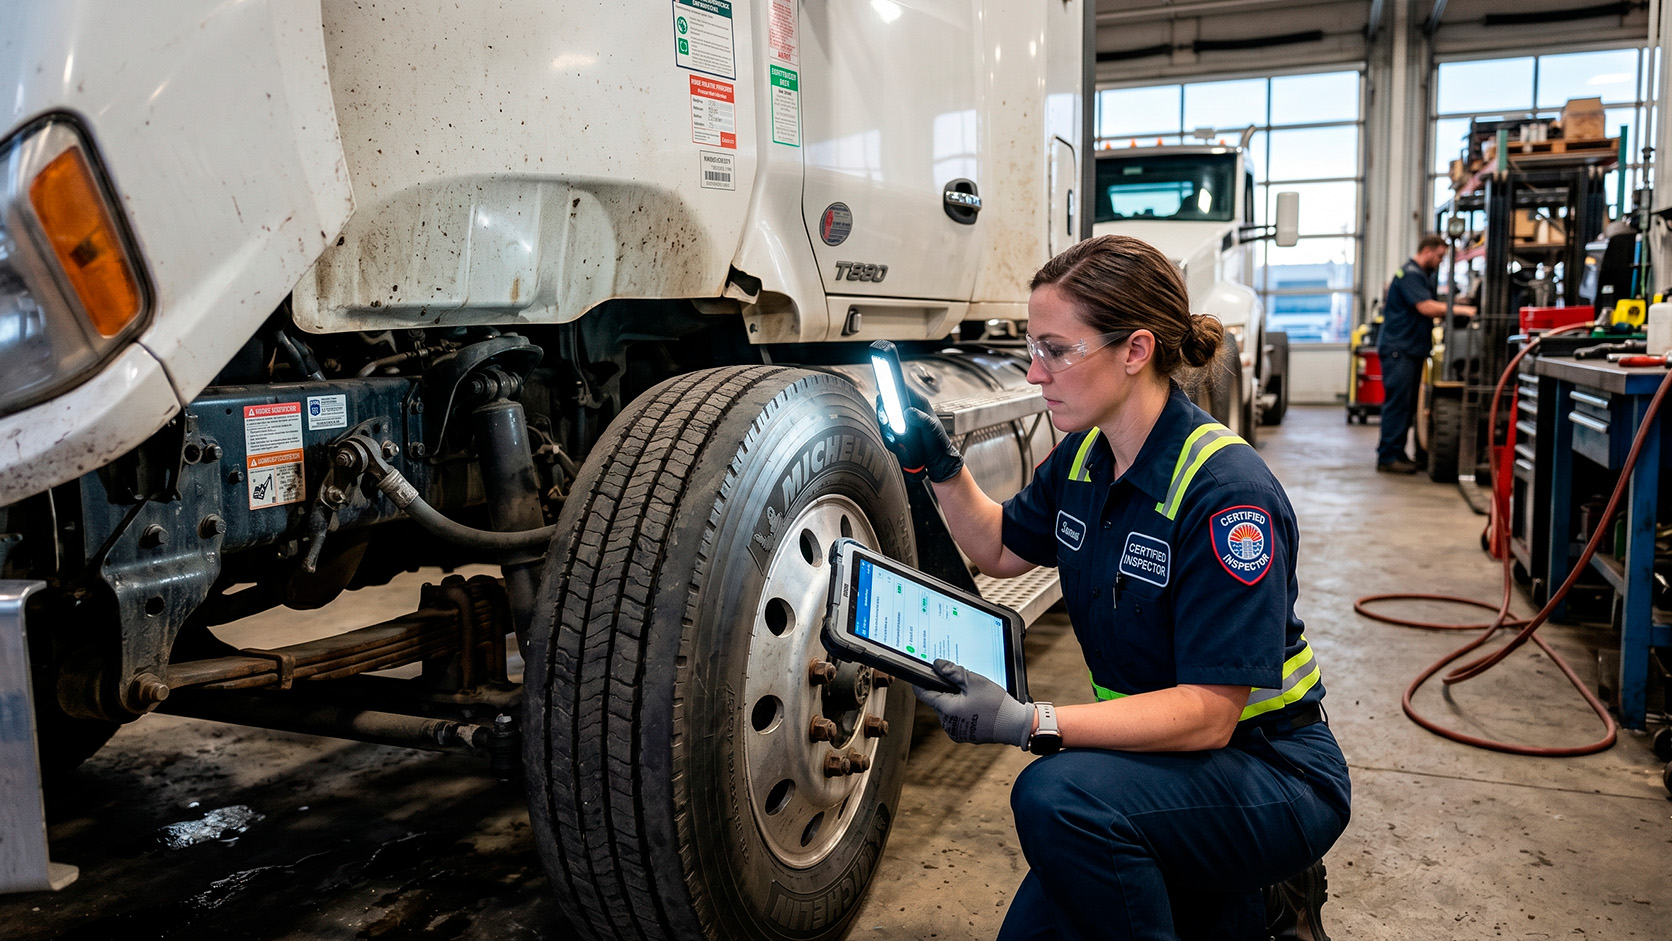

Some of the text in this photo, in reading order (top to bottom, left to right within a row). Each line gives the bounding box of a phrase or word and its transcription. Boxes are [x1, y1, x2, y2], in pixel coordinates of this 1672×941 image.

[835, 260, 888, 283] T880
[782, 434, 886, 512] MICHELIN
[1220, 511, 1266, 527] CERTIFIED
[1128, 543, 1167, 563] CERTIFIED
[1222, 553, 1270, 571] INSPECTOR
[1123, 554, 1166, 578] INSPECTOR
[770, 845, 875, 931] MICHELIN
